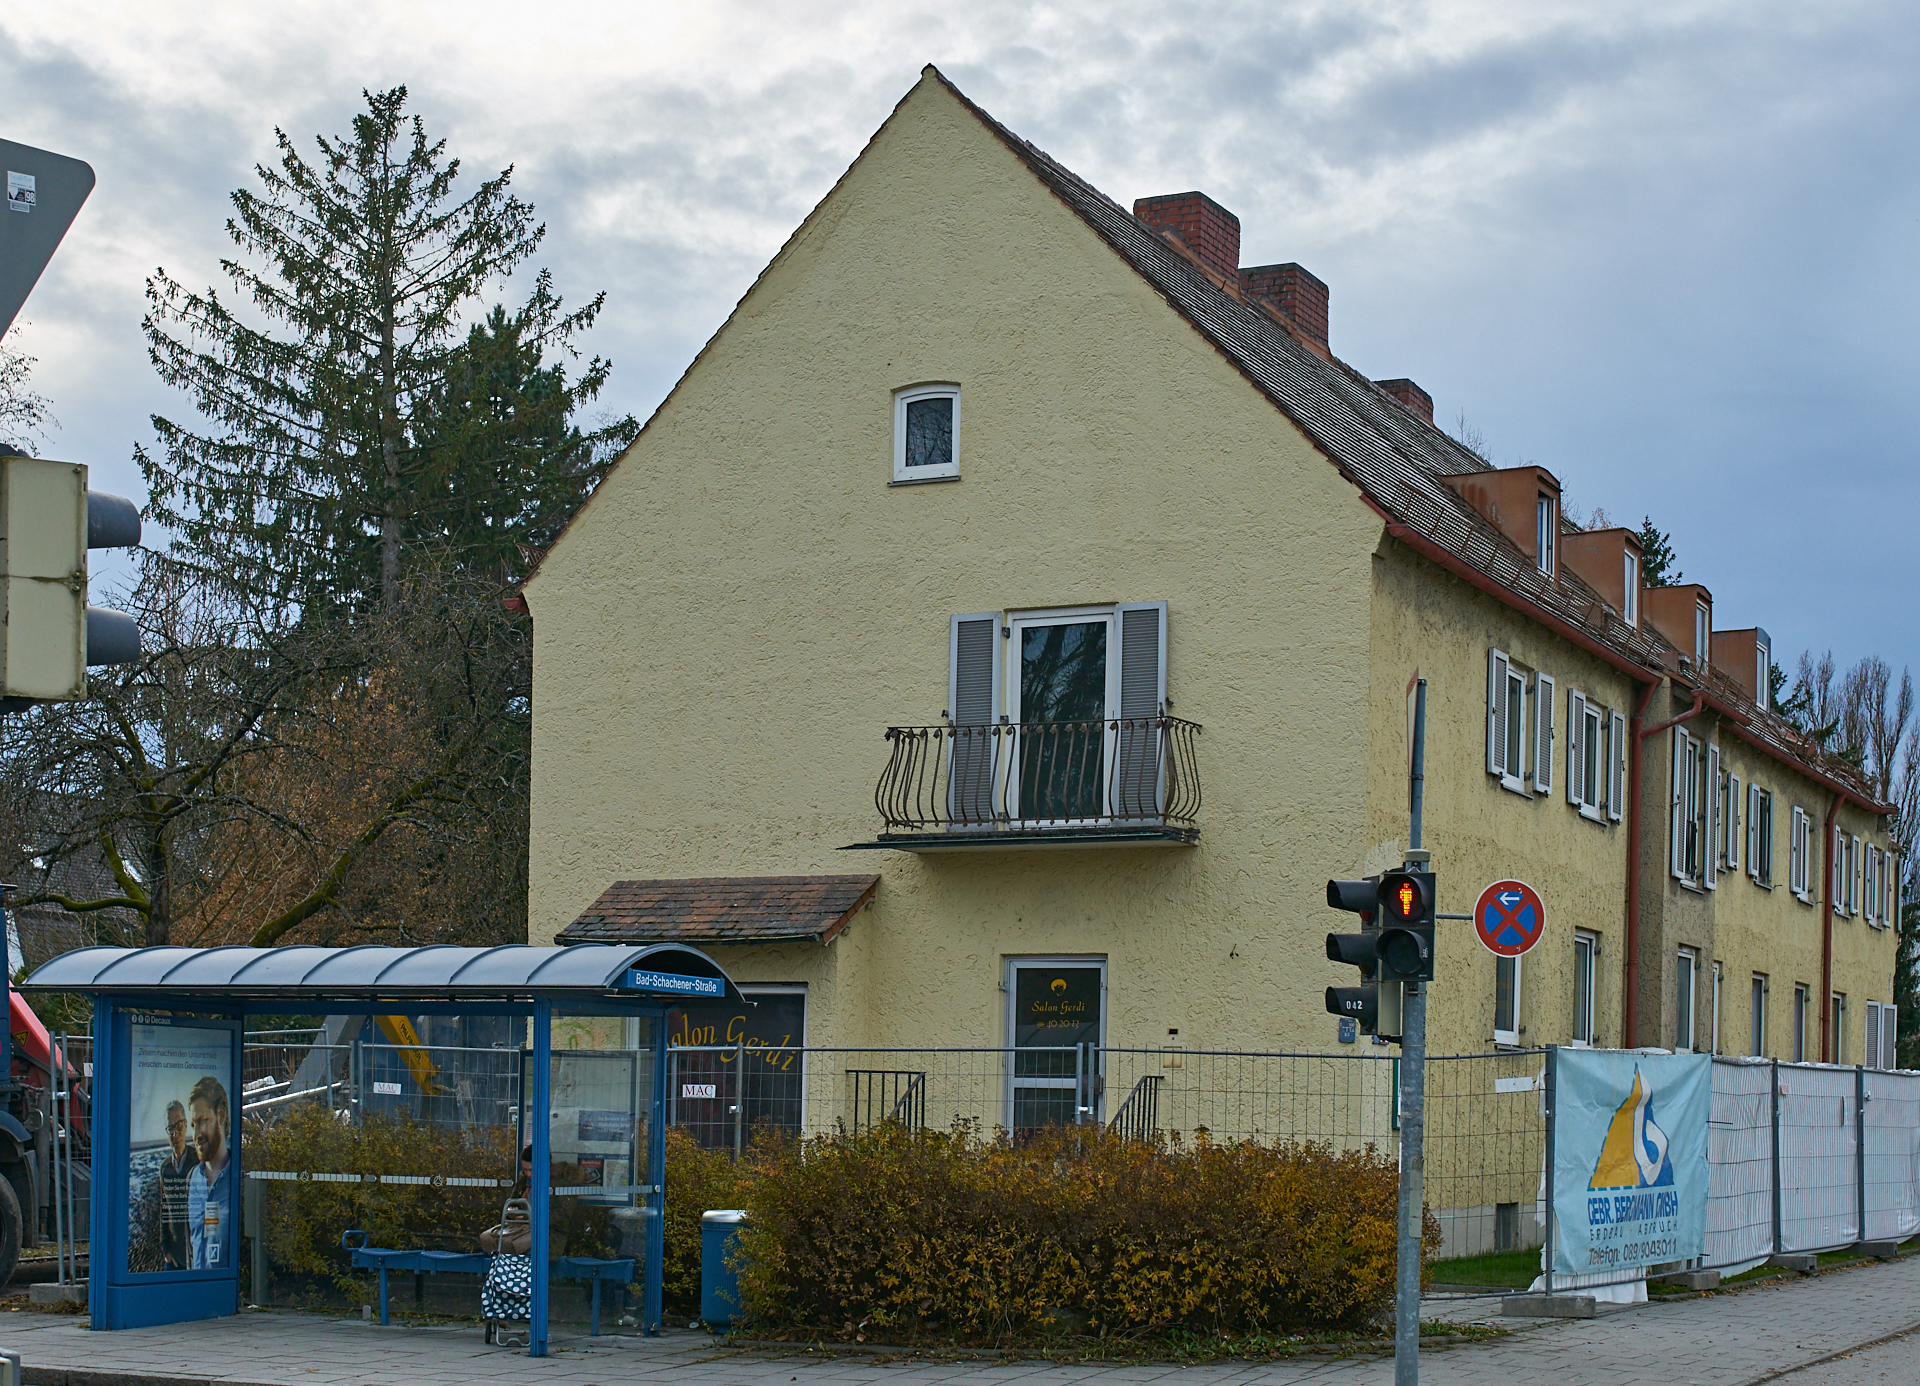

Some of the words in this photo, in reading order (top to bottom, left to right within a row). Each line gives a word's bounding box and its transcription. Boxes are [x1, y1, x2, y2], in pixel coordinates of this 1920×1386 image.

[636, 973, 717, 992] Bad-Schachener-Straße
[1032, 1001, 1058, 1012] Salon
[1060, 1001, 1085, 1014] Gerdi
[1346, 1001, 1363, 1010] 042
[1059, 1020, 1070, 1028] 20
[685, 1086, 714, 1097] MAC
[1588, 1197, 1614, 1225] GEBR.
[1589, 1226, 1624, 1241] ERDBAU
[1589, 1246, 1620, 1266] Telefon:
[1624, 1238, 1677, 1261] 089/9043011
